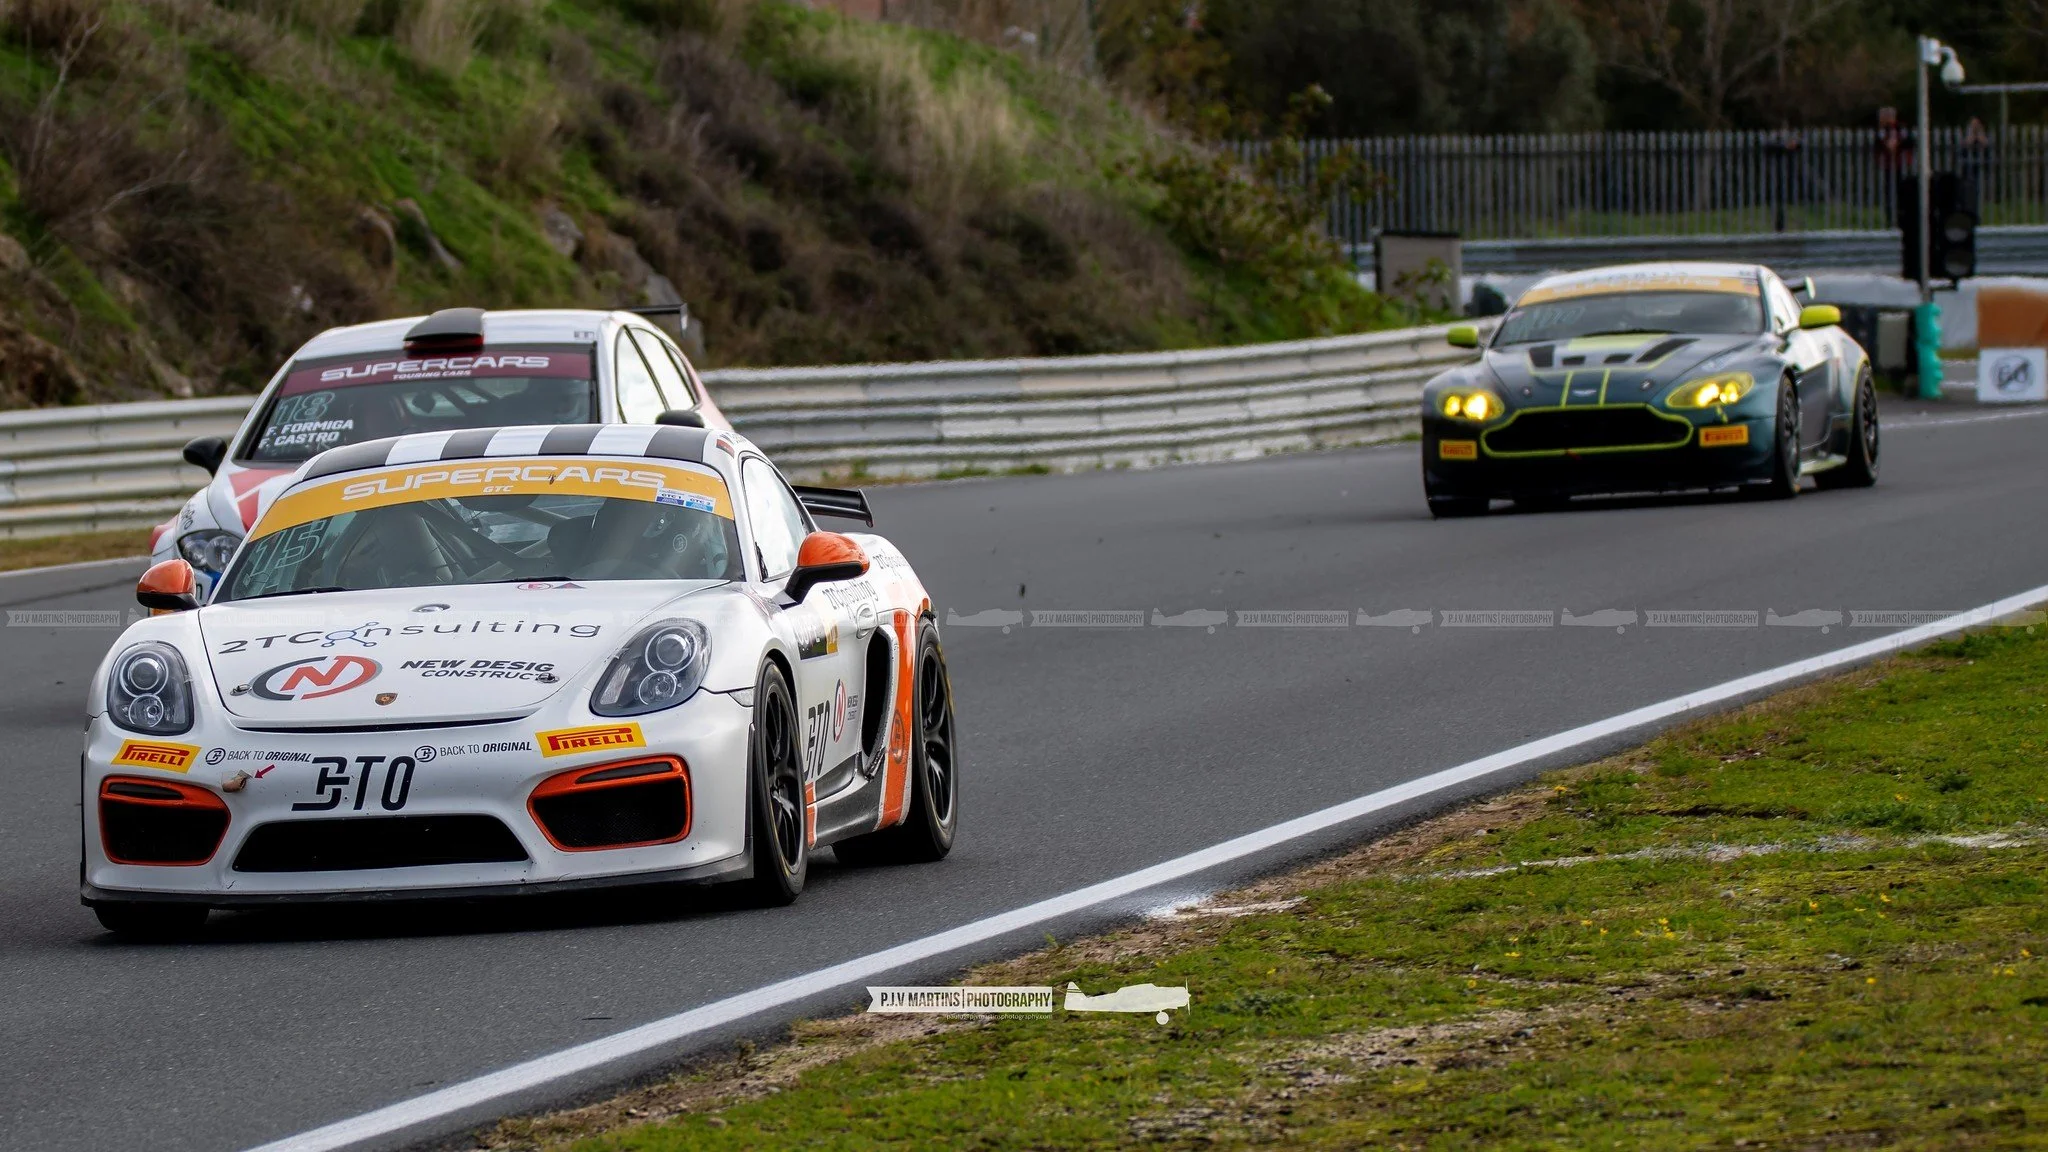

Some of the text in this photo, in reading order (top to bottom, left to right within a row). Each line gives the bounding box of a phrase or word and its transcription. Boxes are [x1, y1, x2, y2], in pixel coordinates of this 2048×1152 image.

[320, 356, 550, 382] SUPERCARS
[393, 369, 472, 381] TOURING CARS
[265, 419, 354, 437] F. FORMIGA
[274, 431, 339, 447] CASTRO
[341, 465, 667, 500] SUPERCARS
[483, 485, 514, 494] GTC
[400, 660, 554, 672] NEW DESIG
[548, 727, 634, 750] PIRELLI
[120, 744, 189, 766] PIRELLI
[227, 750, 250, 760] BACK
[252, 751, 264, 761] TO
[265, 751, 313, 763] ORIGINAL
[440, 746, 465, 756] BACK
[467, 744, 480, 754] TO
[482, 742, 532, 753] ORIGINAL
[291, 755, 416, 811] BTO
